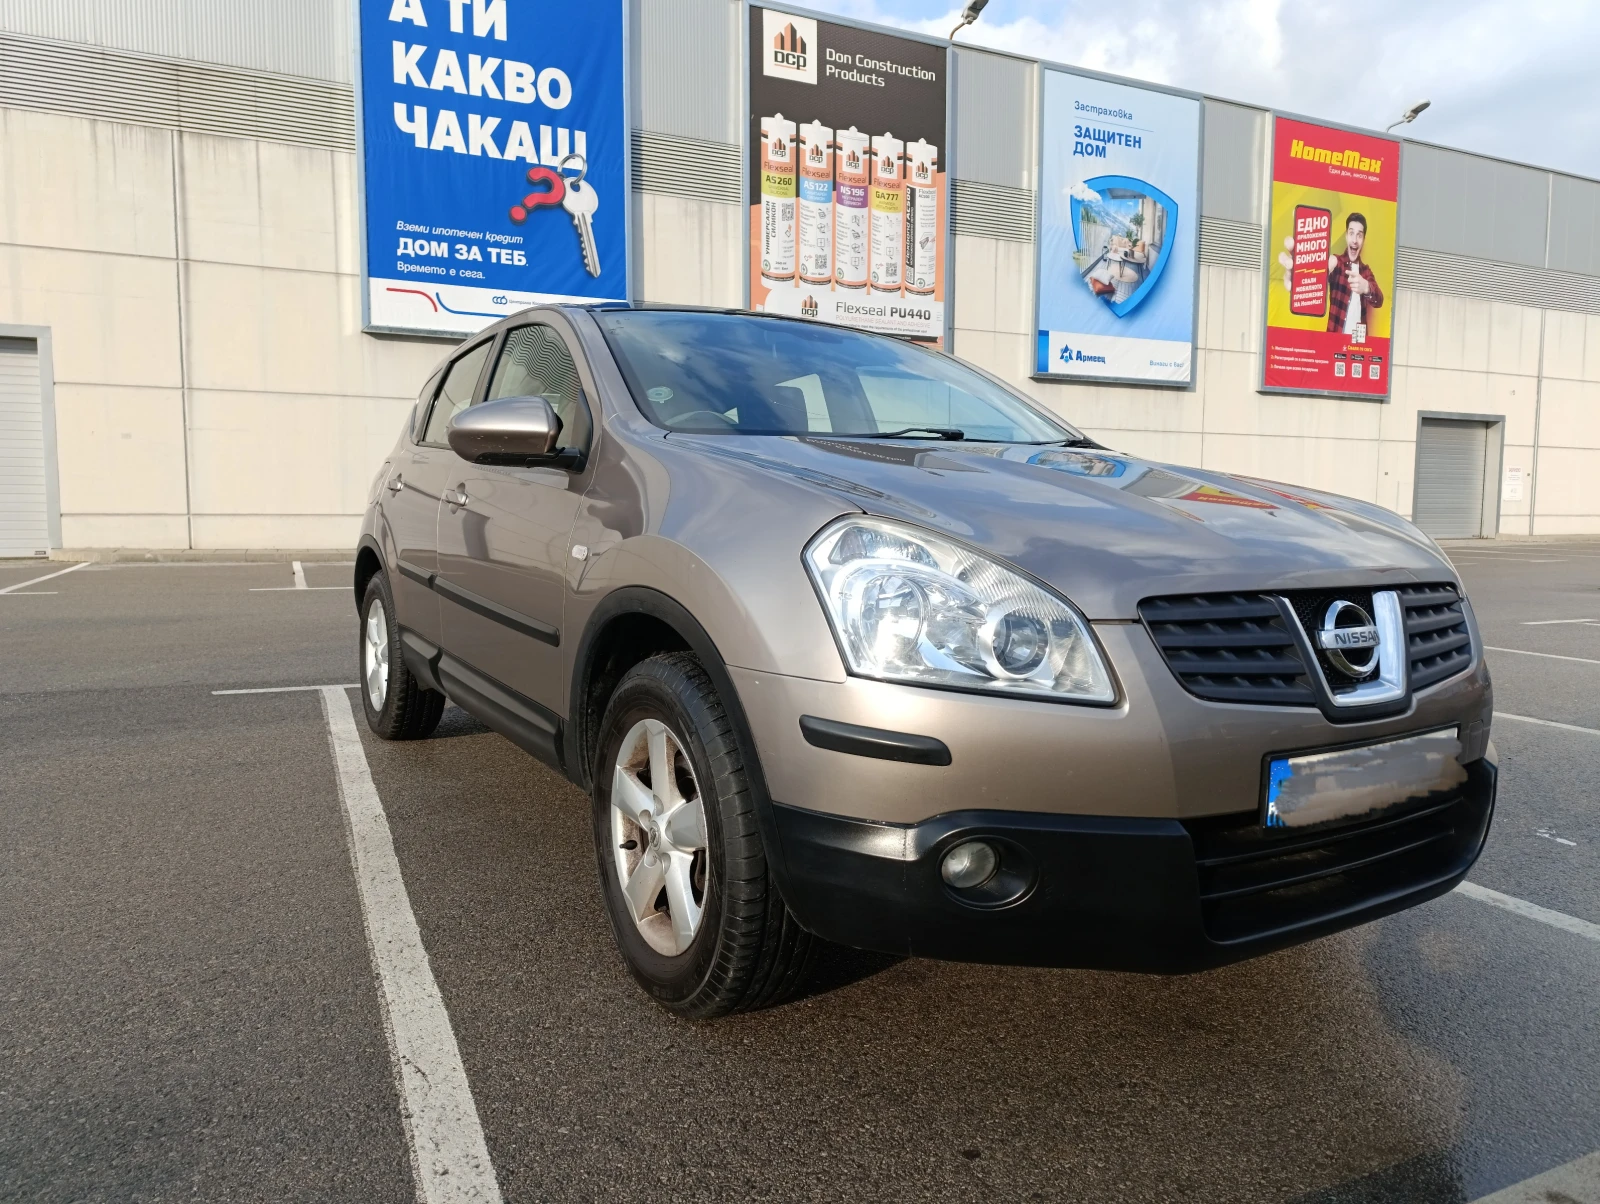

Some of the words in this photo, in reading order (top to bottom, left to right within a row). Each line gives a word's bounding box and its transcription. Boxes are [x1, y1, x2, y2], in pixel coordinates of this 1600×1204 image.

[448, 0, 508, 41] ТИ
[826, 48, 852, 64] Don
[855, 54, 936, 81] Construction
[392, 40, 572, 110] КАКВО
[826, 65, 885, 87] Products
[1074, 100, 1133, 121] Застраховка
[393, 102, 587, 170] ЧАКАШ
[1073, 125, 1142, 149] ЗАЩИТЕН
[1073, 141, 1107, 158] ДОМ
[1290, 139, 1382, 174] HomeMax
[764, 161, 793, 173] Flexseal
[802, 167, 830, 179] Flexseal
[839, 173, 867, 184] Flexseal
[873, 178, 900, 188] Flexseal
[396, 220, 429, 234] Вземи
[432, 226, 483, 240] ипотечен
[485, 231, 524, 245] кредит
[1297, 216, 1328, 233] ЕДНО
[397, 237, 449, 258] ДОМ
[454, 244, 483, 262] ЗА
[487, 247, 529, 267] ТЕБ.
[1296, 239, 1327, 253] МНОГО
[1296, 251, 1326, 265] БОНУСИ
[397, 261, 446, 275] Времето
[449, 267, 456, 277] е
[459, 269, 486, 279] сега.
[836, 301, 887, 317] Flexseal
[890, 307, 931, 321] PU440
[1075, 350, 1106, 364] Армеец
